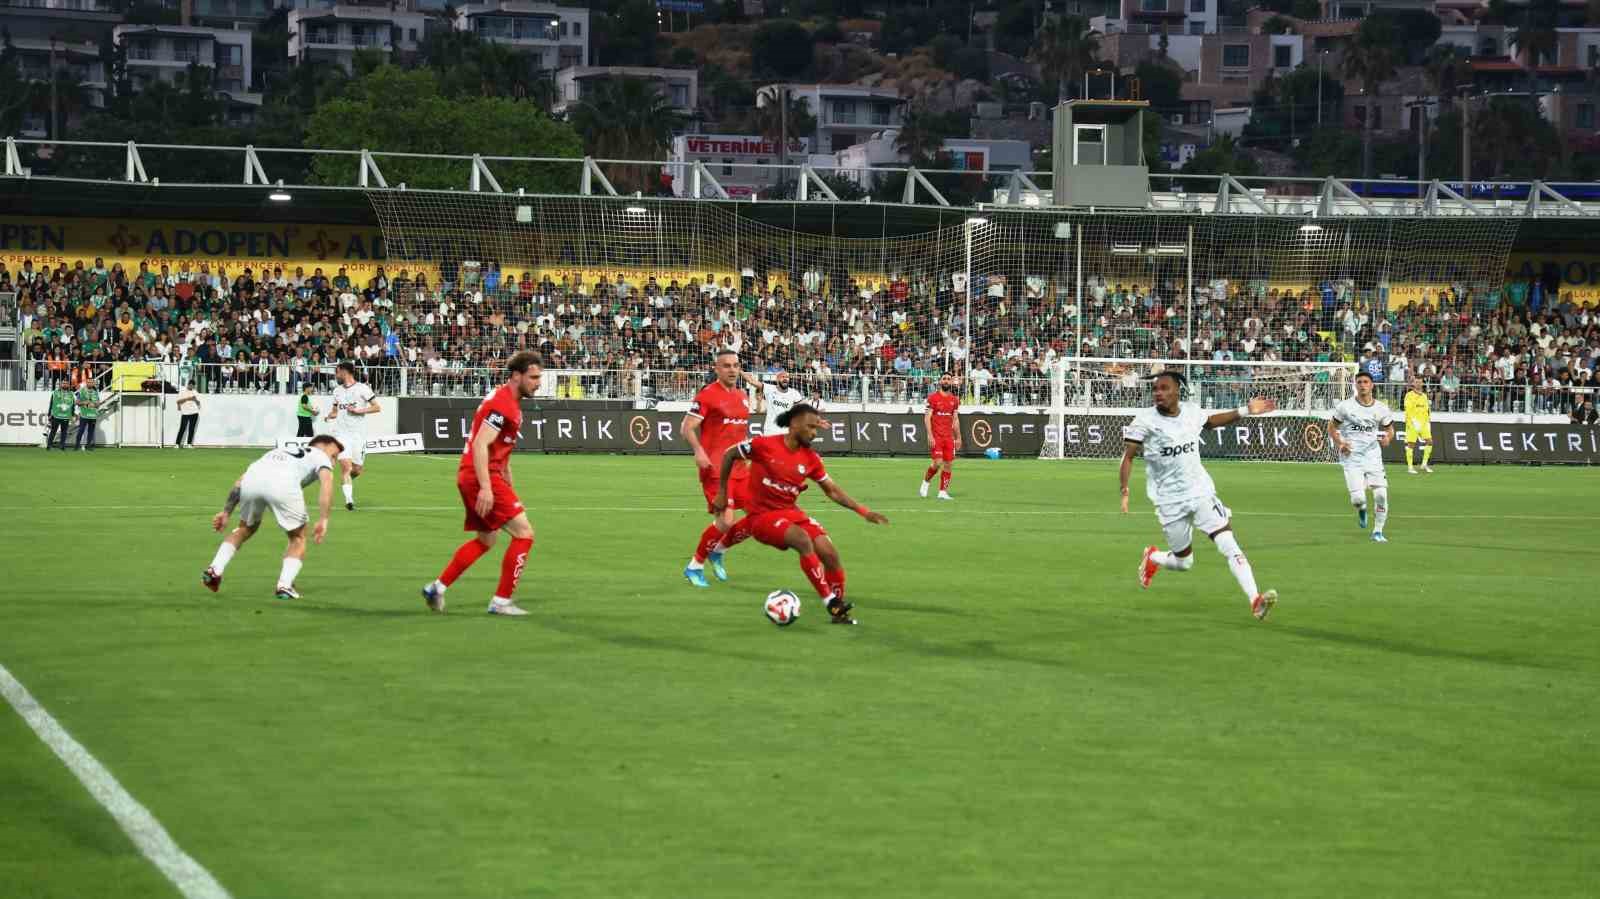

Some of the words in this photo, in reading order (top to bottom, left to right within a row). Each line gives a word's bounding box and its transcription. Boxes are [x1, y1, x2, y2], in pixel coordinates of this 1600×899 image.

[145, 229, 289, 258] ADOPEN
[434, 414, 613, 440] ELTRİK
[366, 438, 417, 449] eton
[1160, 442, 1196, 457] opet
